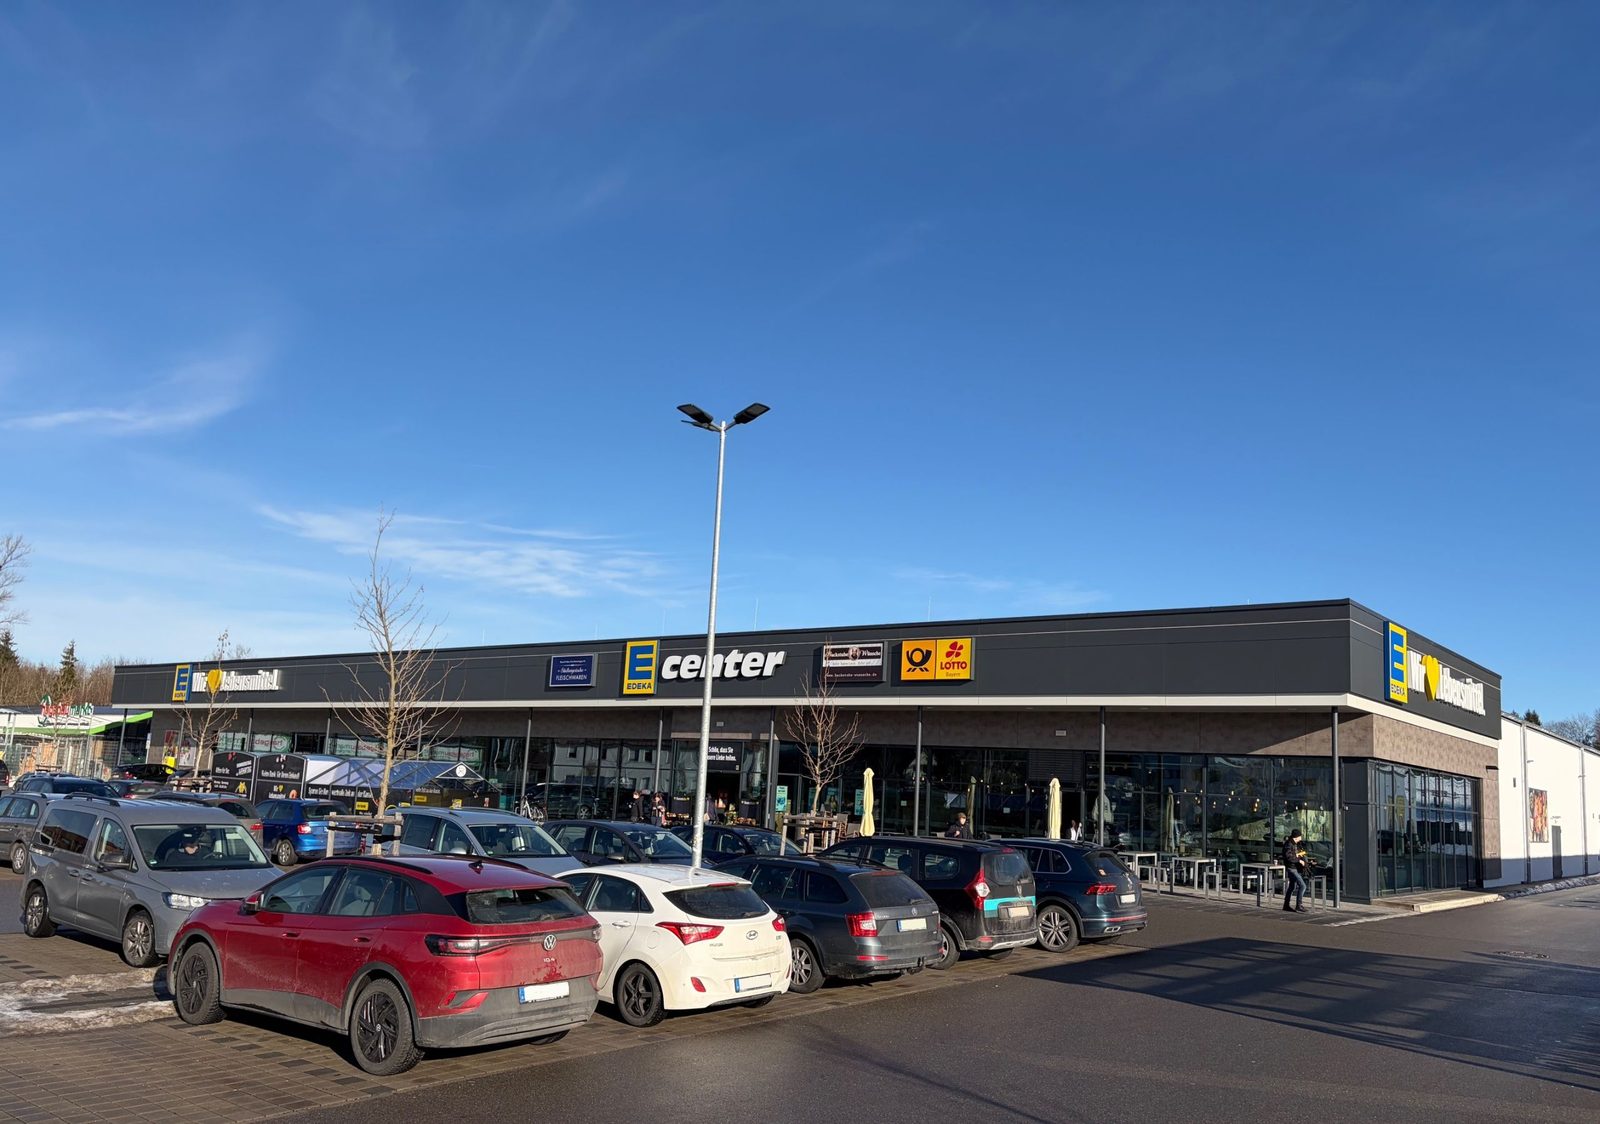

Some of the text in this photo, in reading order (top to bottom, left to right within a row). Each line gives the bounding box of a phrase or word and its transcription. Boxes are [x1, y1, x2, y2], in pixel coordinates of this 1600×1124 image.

[628, 645, 653, 680] E
[662, 650, 785, 680] center
[940, 661, 968, 670] LOTTO
